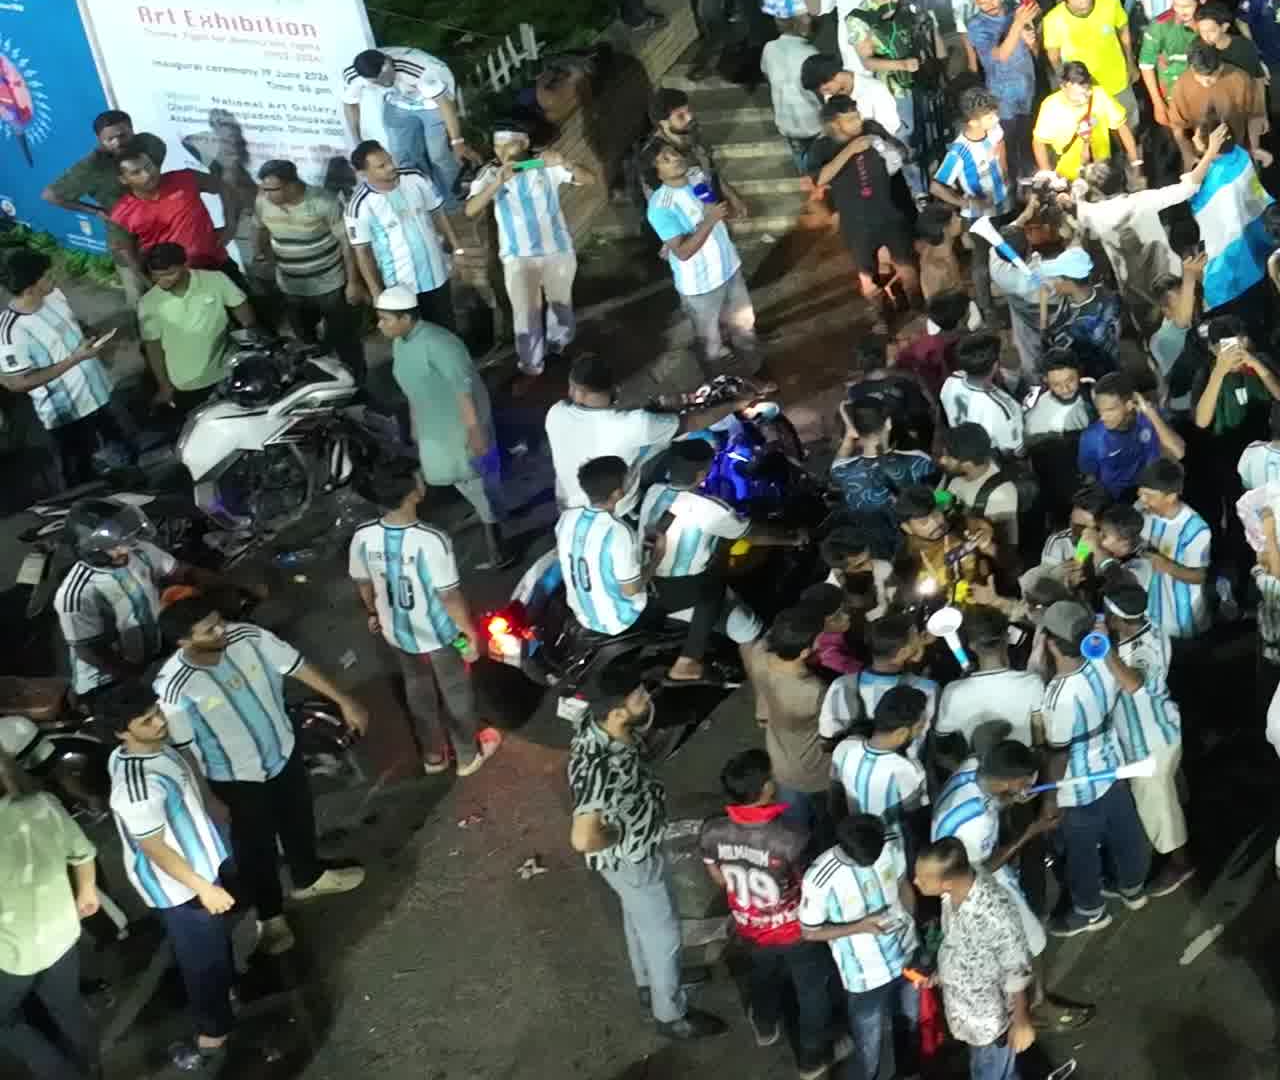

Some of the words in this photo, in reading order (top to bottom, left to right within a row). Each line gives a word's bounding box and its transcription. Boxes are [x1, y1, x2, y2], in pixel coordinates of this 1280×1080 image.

[137, 5, 177, 25] Art
[183, 9, 318, 38] Exhibition
[379, 572, 416, 611] 10
[569, 554, 592, 593] 10
